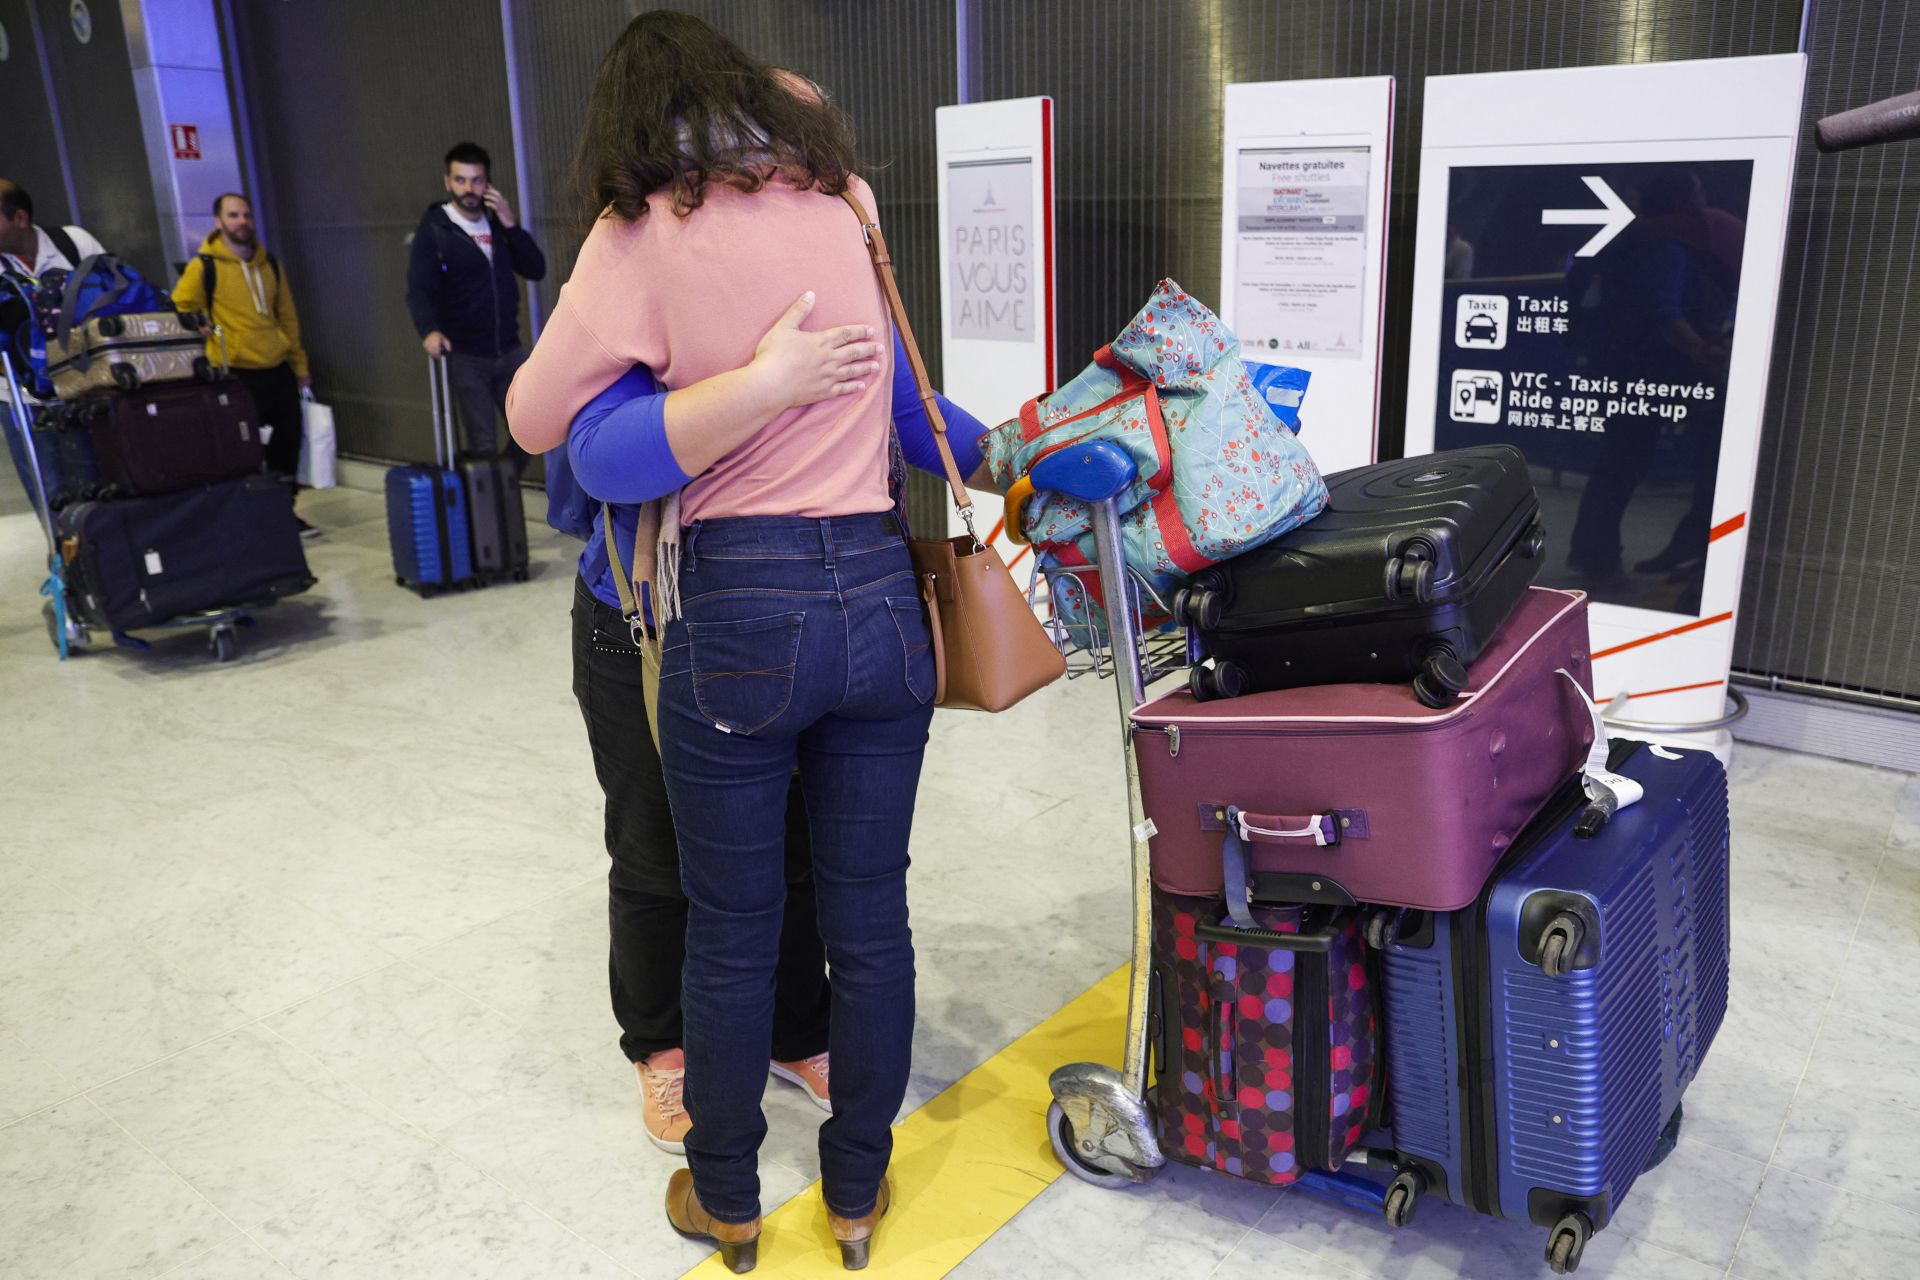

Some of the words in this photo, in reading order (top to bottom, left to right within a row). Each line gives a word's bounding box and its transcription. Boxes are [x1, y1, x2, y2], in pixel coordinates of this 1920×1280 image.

[1259, 162, 1300, 171] Navettes
[1302, 160, 1345, 172] gratuites
[1271, 173, 1292, 183] Free
[1294, 173, 1331, 182] shuttles
[955, 223, 1025, 257] PARIS
[958, 262, 1027, 294] VOUS
[959, 298, 1025, 332] AIME
[1468, 299, 1498, 311] Taxis
[1517, 295, 1569, 313] Taxis
[1516, 316, 1569, 335] 出租车
[1510, 371, 1549, 390] VTC
[1568, 375, 1619, 394] Taxis
[1625, 379, 1716, 400] réservés
[1509, 390, 1553, 410] Ride
[1560, 396, 1600, 417] app
[1606, 397, 1688, 422] pick-up
[1507, 410, 1606, 433] 网约车上客区
